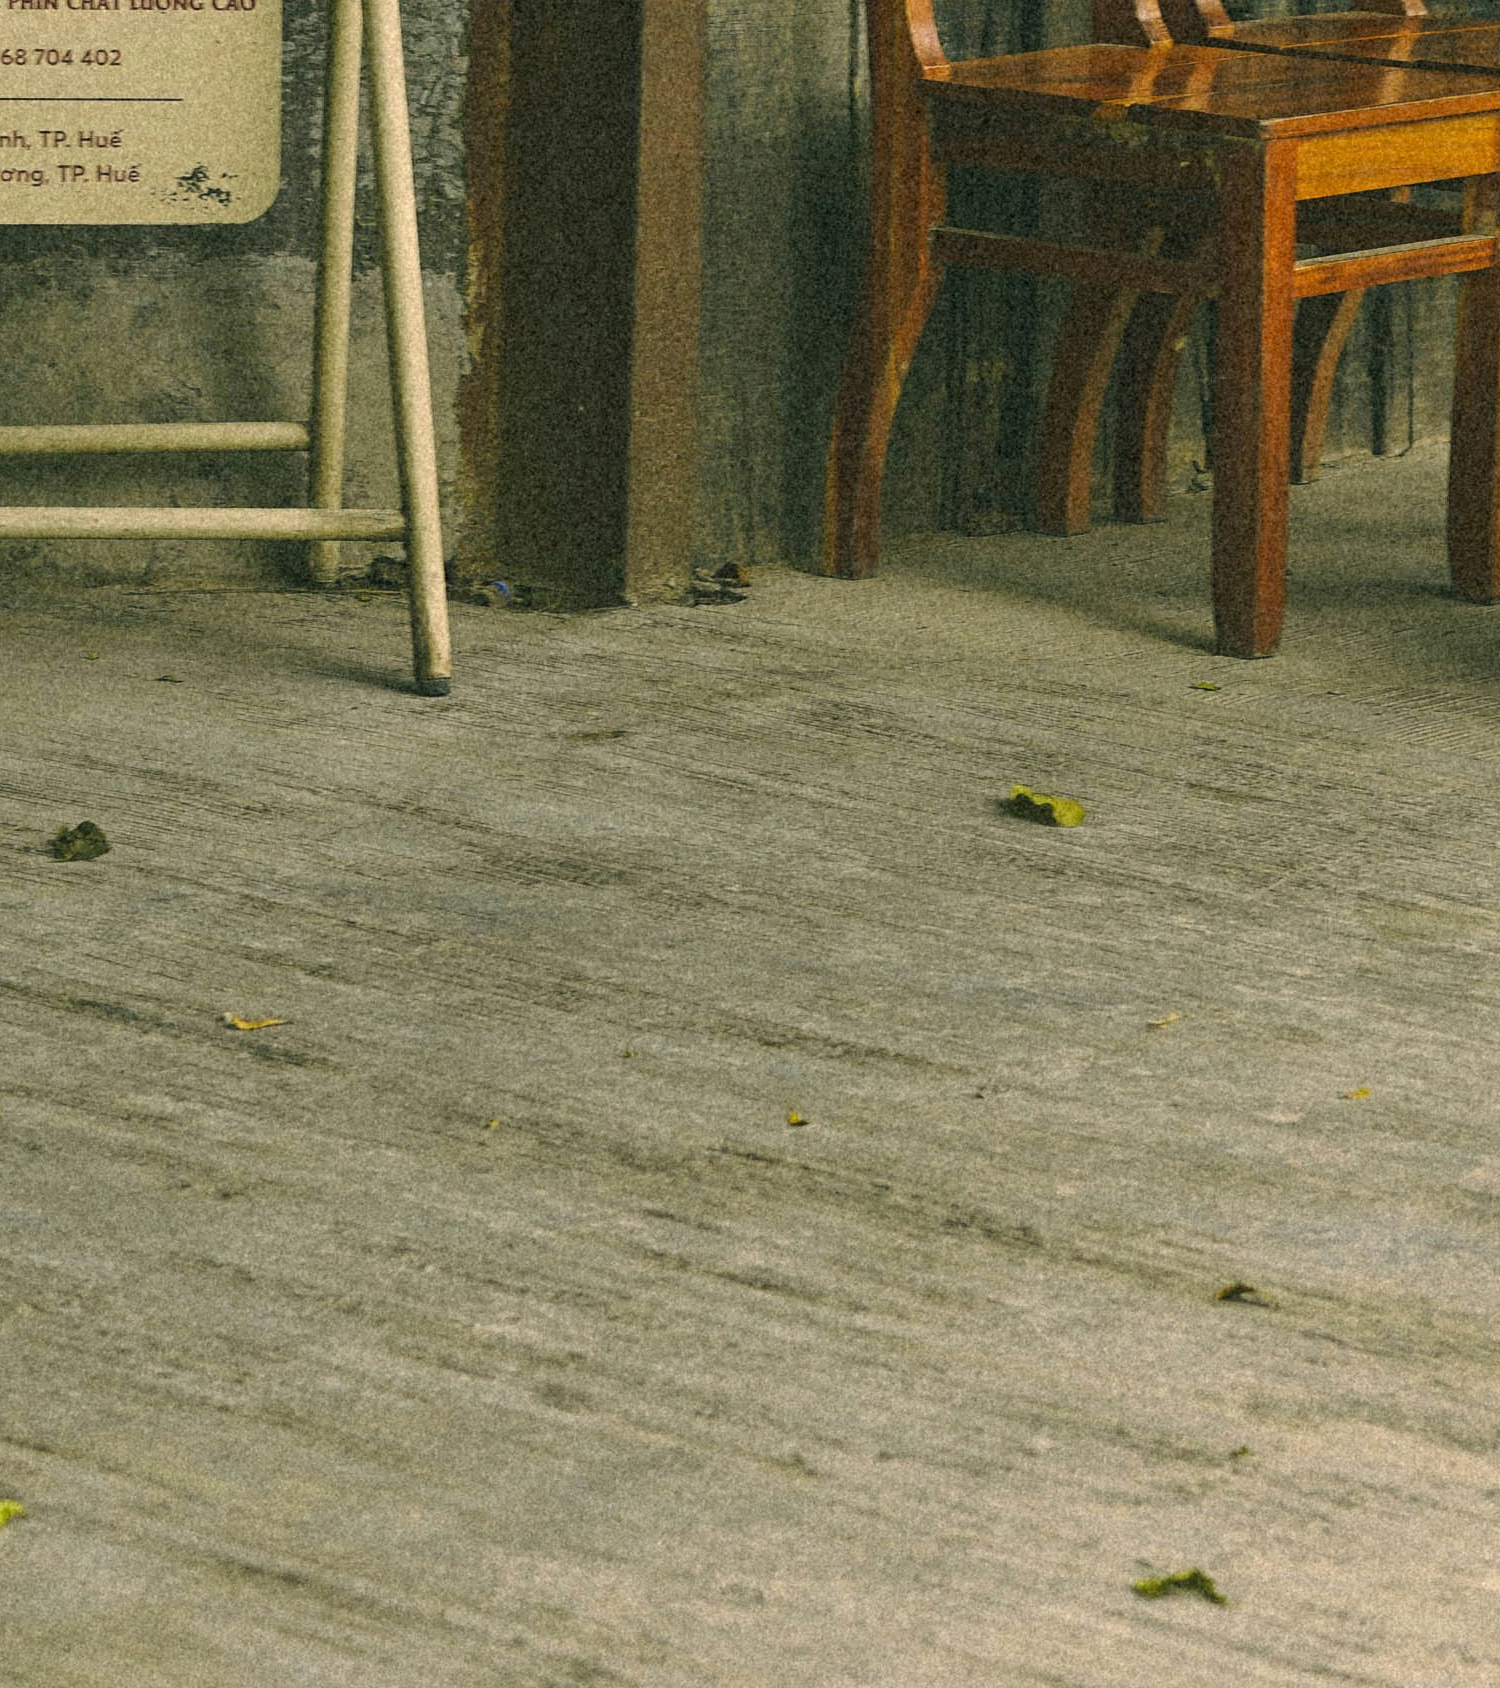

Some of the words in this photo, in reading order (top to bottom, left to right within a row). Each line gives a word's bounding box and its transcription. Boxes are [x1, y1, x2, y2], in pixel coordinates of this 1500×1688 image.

[34, 49, 73, 65] 704
[80, 49, 122, 65] 402
[39, 131, 71, 148] TP.
[78, 129, 124, 148] Huế
[58, 165, 89, 182] TP.
[97, 163, 141, 183] Huế
